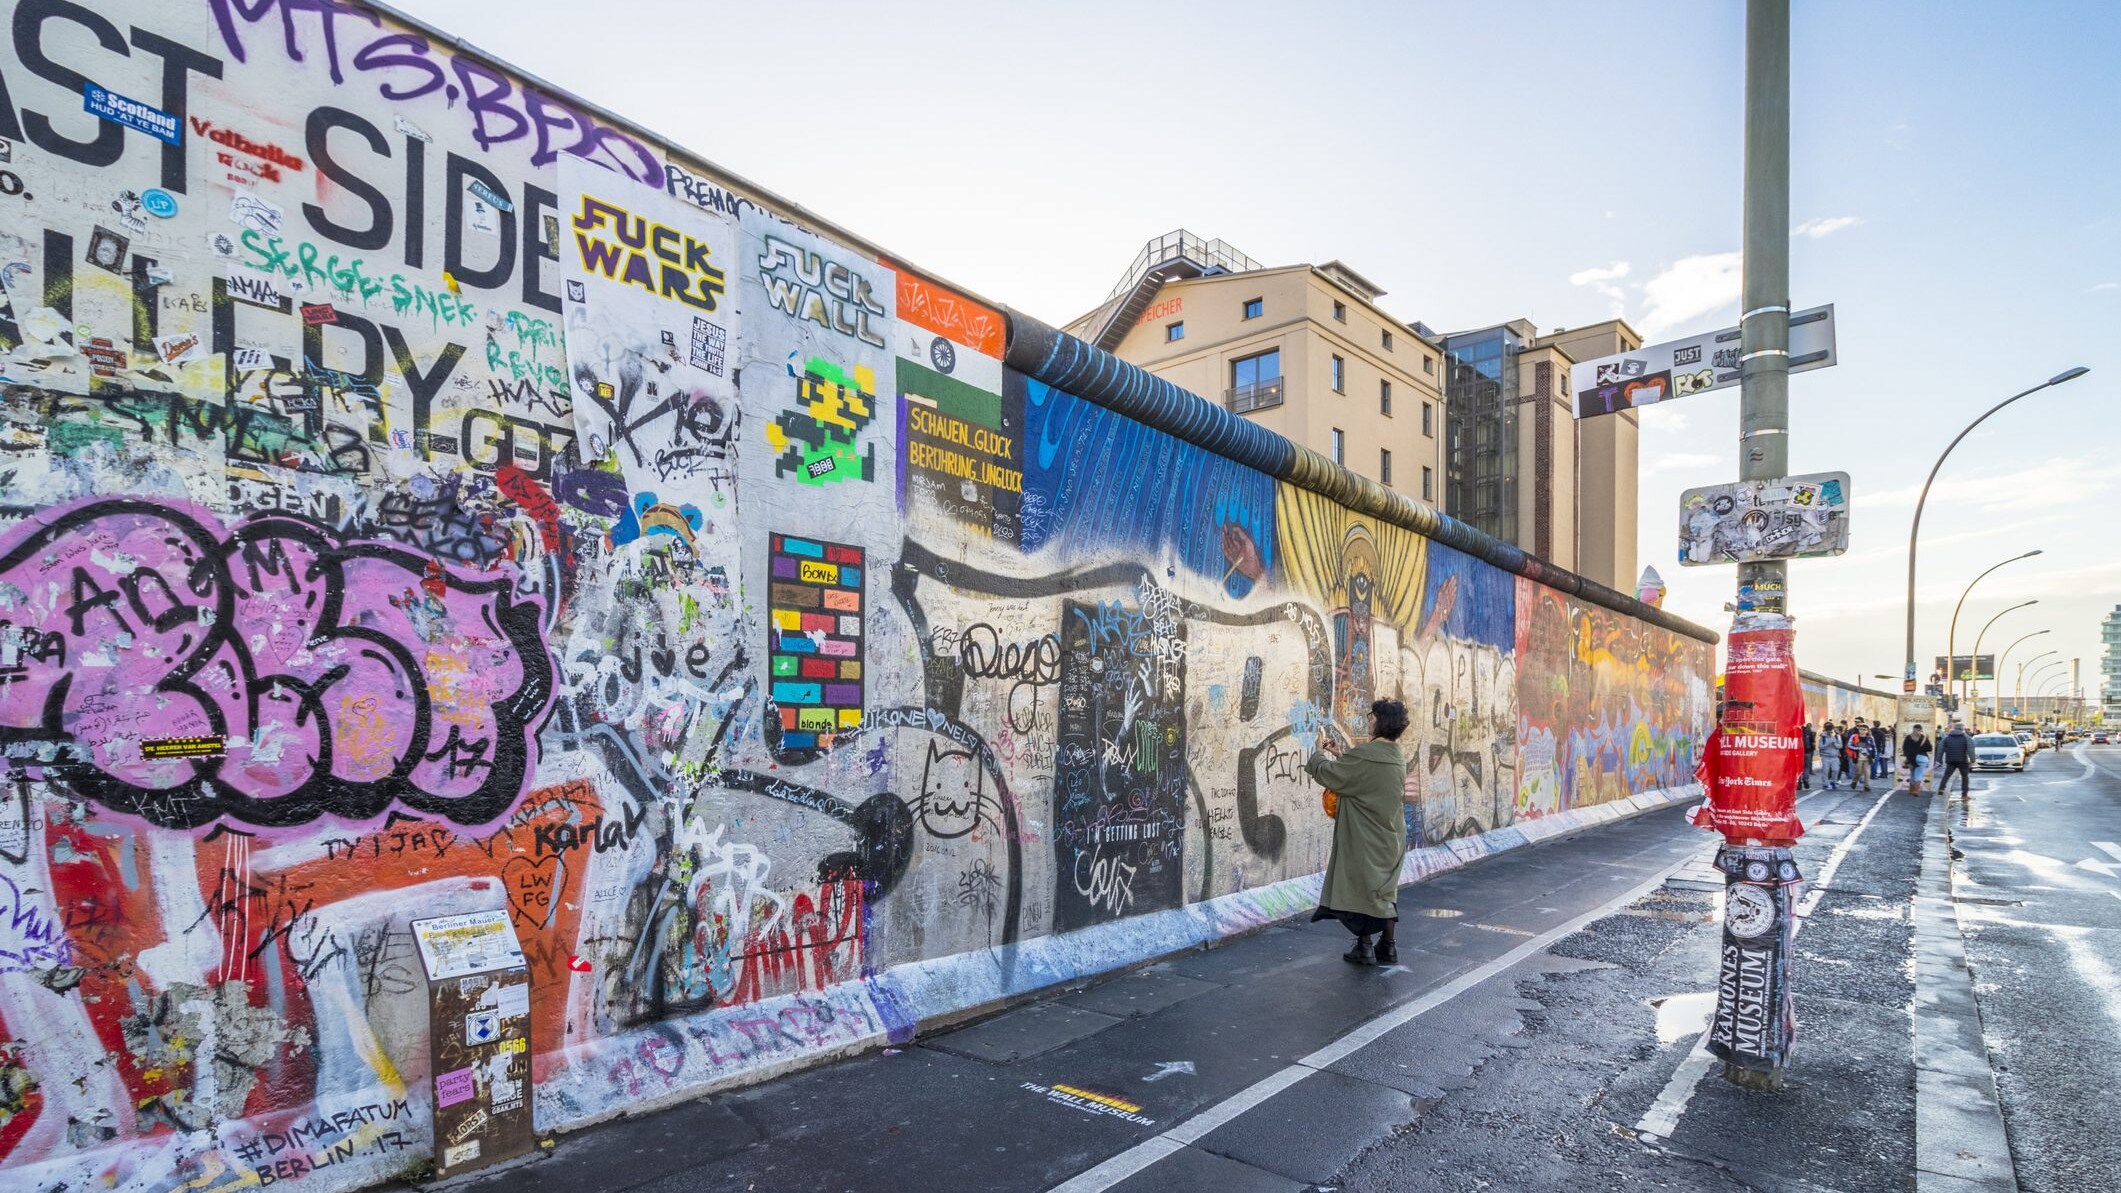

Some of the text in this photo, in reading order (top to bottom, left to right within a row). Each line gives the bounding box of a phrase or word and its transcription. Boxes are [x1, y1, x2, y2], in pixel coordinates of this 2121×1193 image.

[90, 102, 115, 116] HUD
[136, 116, 152, 129] YE
[151, 123, 175, 139] BAM
[107, 93, 176, 131] Scotland
[572, 193, 725, 279] FUCK
[573, 231, 725, 312] WARS
[758, 233, 885, 316] FUCK
[758, 269, 886, 349] WALL
[693, 317, 726, 340] JESUS
[691, 339, 725, 358] THE TRUTH
[692, 330, 725, 350] THE WAY
[690, 356, 708, 372] JOHN
[691, 347, 724, 367] THE LIFE
[1674, 345, 1700, 362] JUST
[1735, 736, 1799, 750] MUSEUM
[1744, 777, 1772, 787] Times
[1105, 824, 1138, 843] GETTING
[1143, 822, 1161, 839] LOST
[520, 872, 551, 889] LW
[524, 888, 551, 906] FG
[431, 921, 467, 931] Berliner
[469, 917, 495, 926] Mauer
[1718, 945, 1739, 1050] RAMONES
[1735, 949, 1767, 1057] MUSEUM
[440, 1072, 471, 1090] party
[442, 1083, 471, 1099] fears
[1020, 1082, 1155, 1127] THE WALL MUSEUM
[236, 1100, 413, 1162] #DIMAFATUM
[257, 1138, 354, 1188] BERLIN
